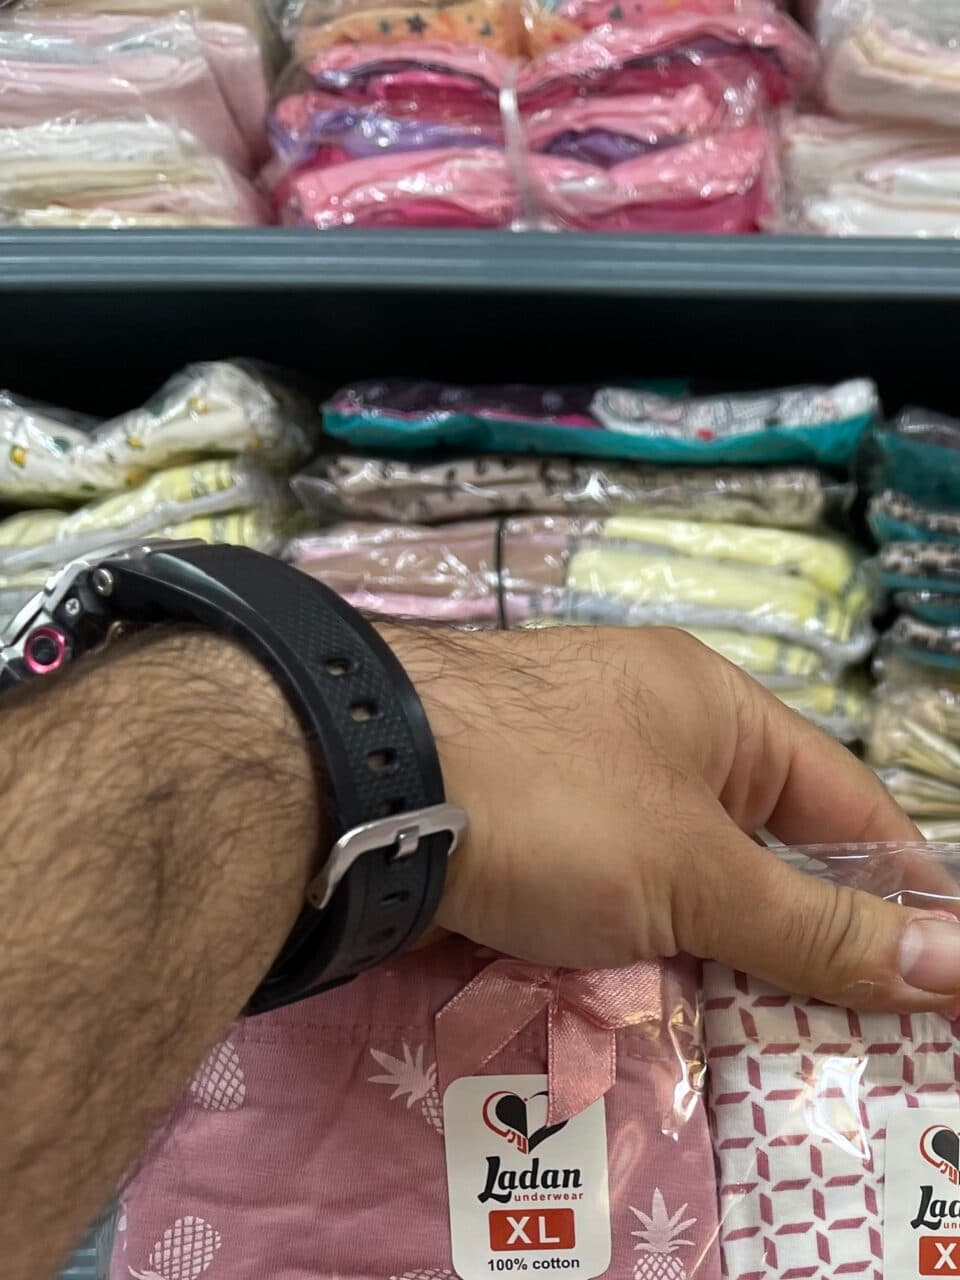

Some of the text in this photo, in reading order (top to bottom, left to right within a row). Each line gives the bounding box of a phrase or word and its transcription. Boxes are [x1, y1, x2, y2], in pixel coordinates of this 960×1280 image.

[478, 1156, 582, 1203] Ladan
[514, 1192, 584, 1202] underwear
[505, 1216, 560, 1245] XL
[487, 1257, 580, 1271] 100% cotton
